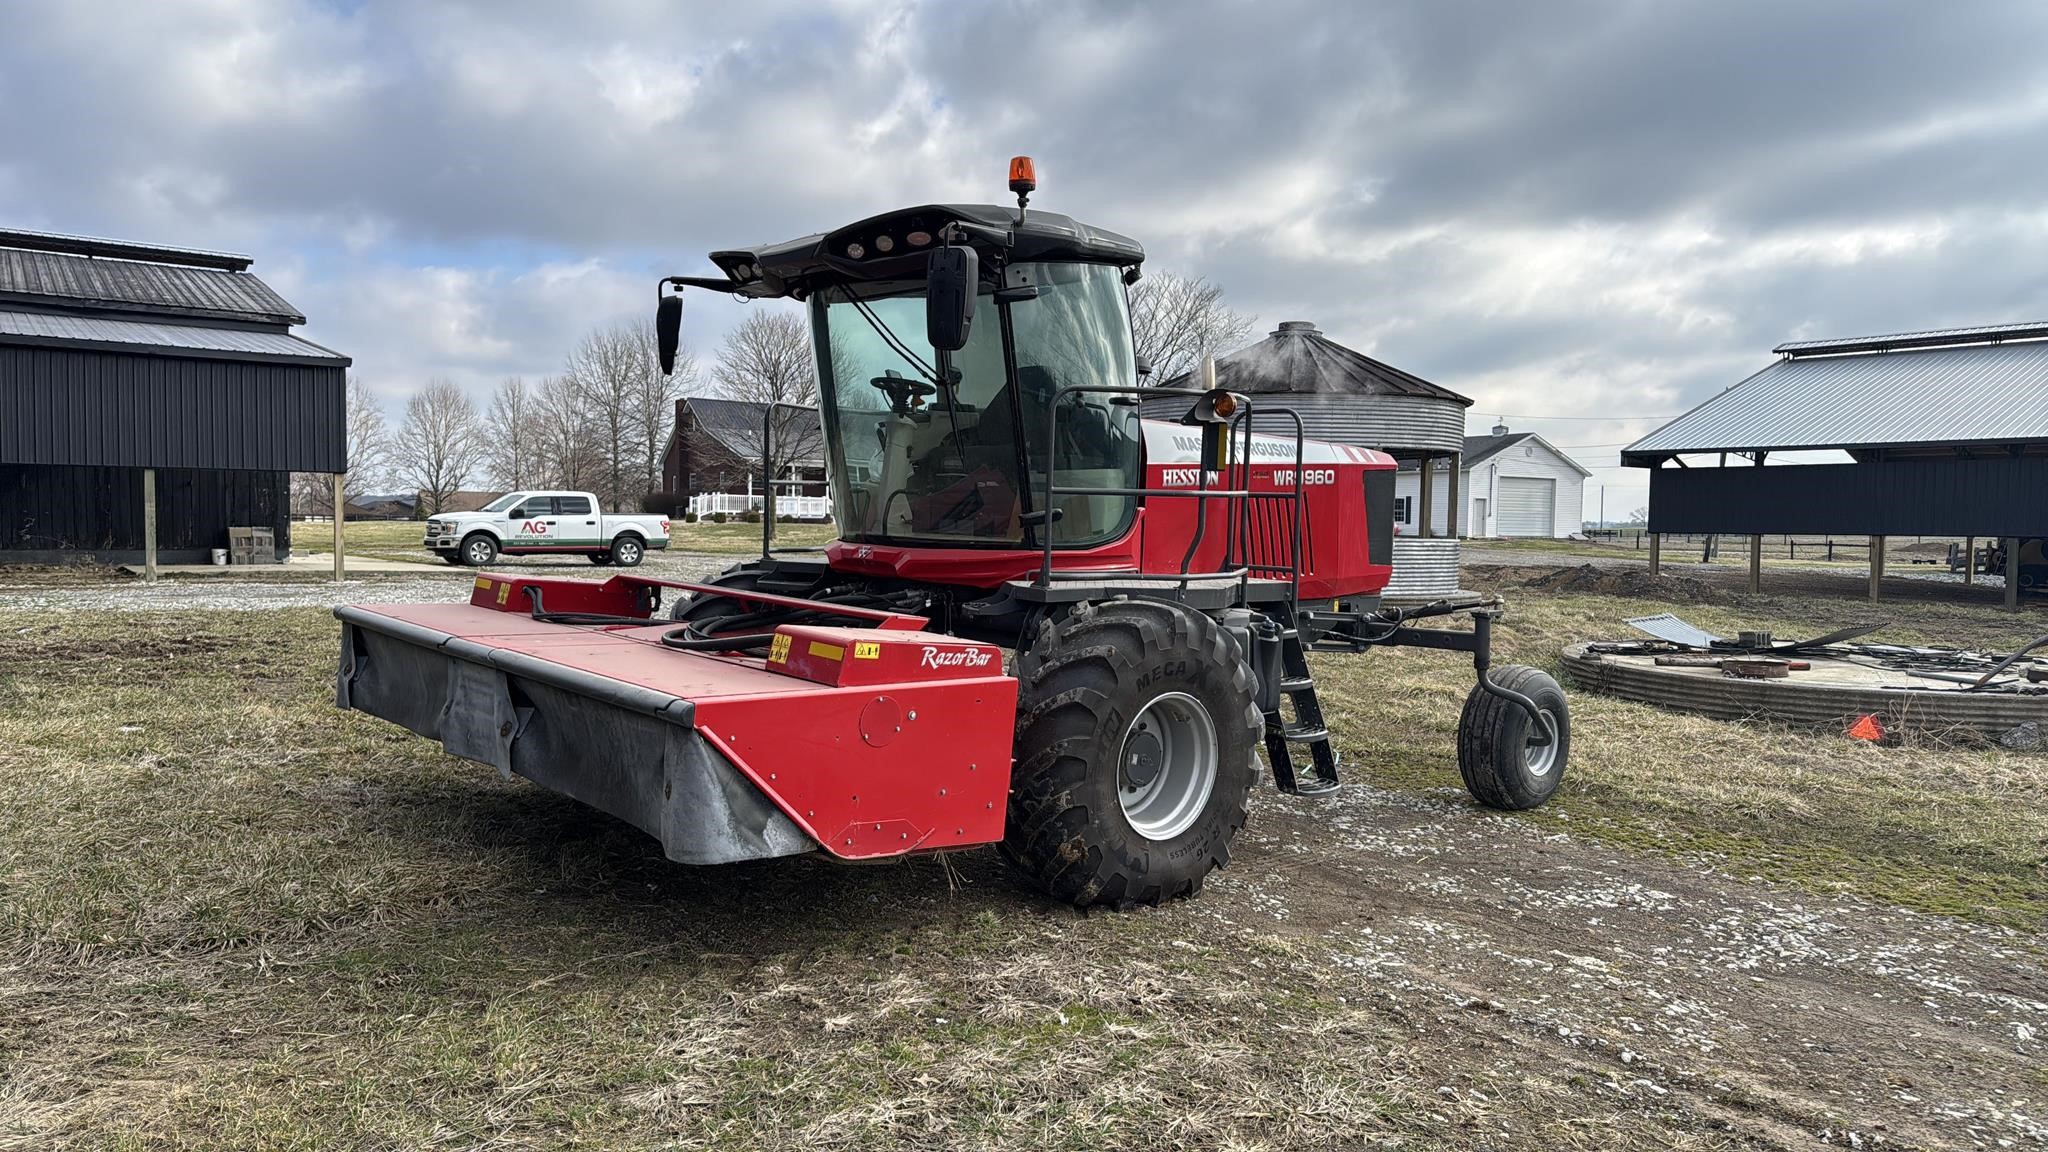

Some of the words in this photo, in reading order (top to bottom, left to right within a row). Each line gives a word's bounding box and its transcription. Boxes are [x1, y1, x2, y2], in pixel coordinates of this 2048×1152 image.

[521, 521, 546, 534] AG
[921, 646, 992, 670] RazorBar
[1136, 661, 1186, 692] MEGA
